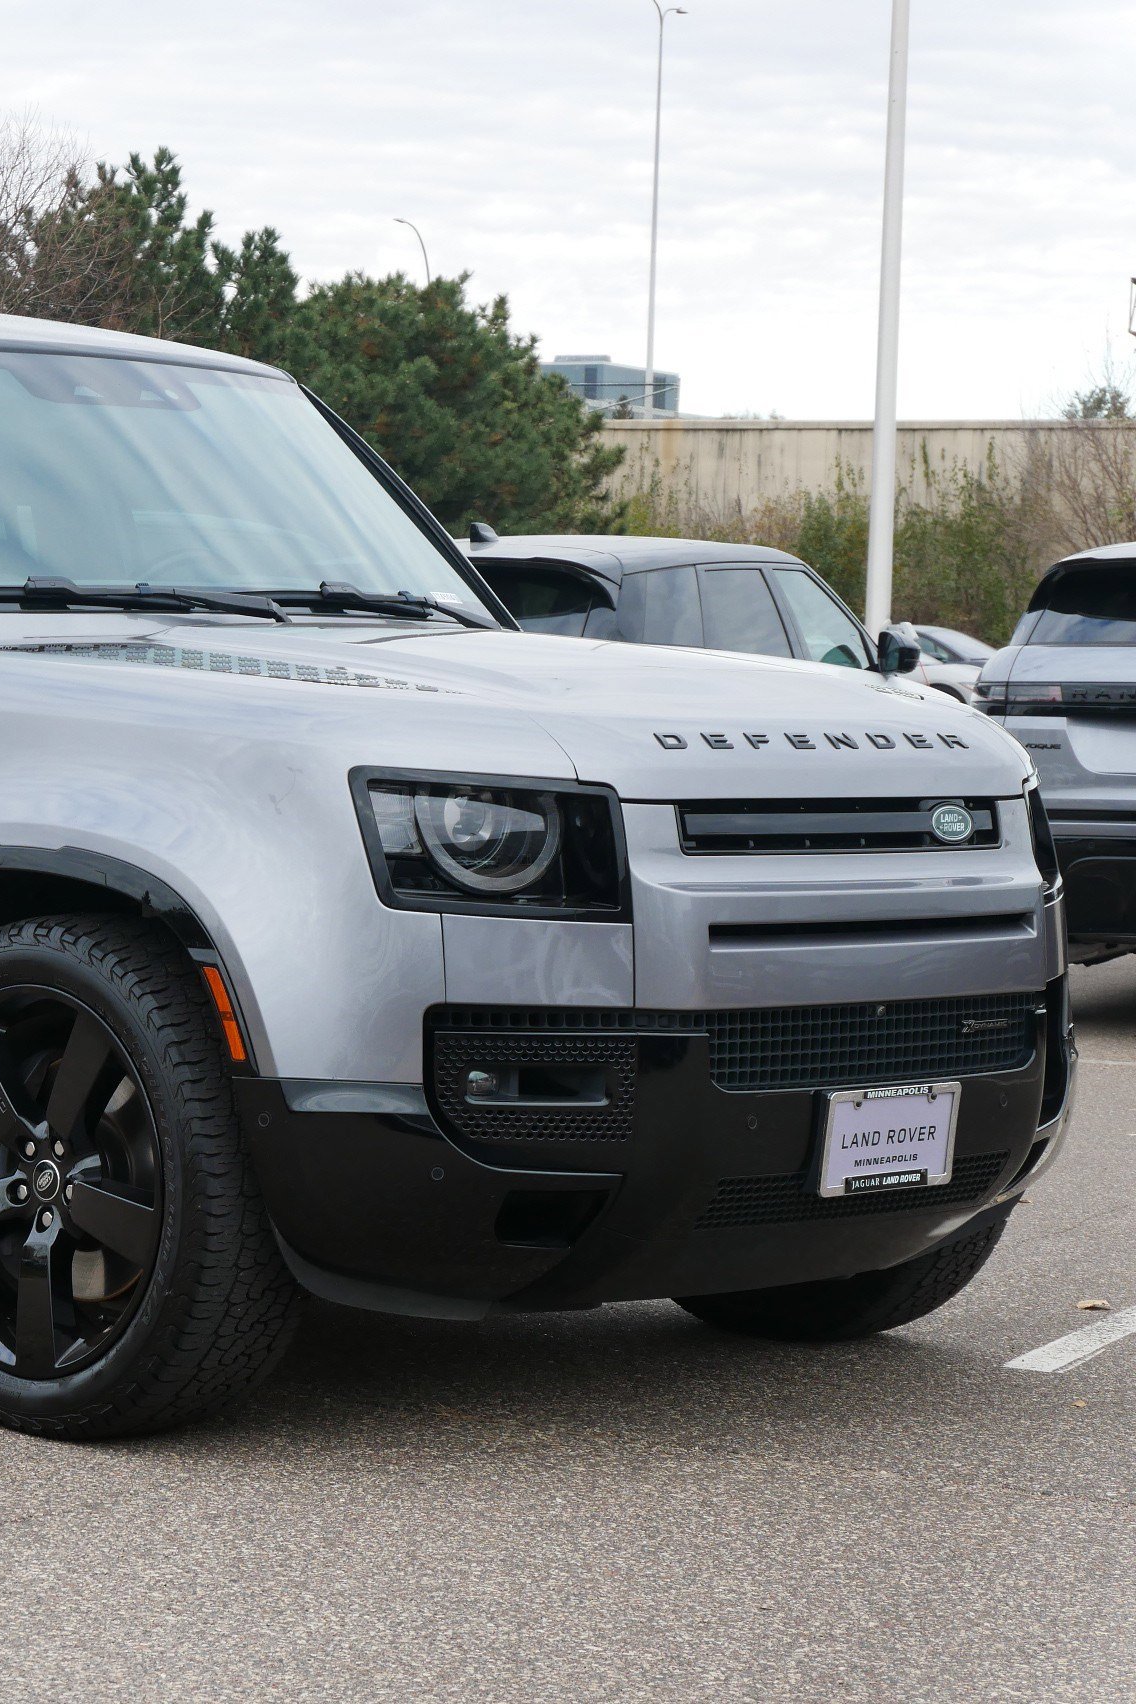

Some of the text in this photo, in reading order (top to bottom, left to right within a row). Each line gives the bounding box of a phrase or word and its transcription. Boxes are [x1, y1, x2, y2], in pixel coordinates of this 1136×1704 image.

[653, 732, 970, 749] DEFENDER
[940, 813, 958, 823] LAND
[943, 822, 965, 832] ROVER
[867, 1086, 929, 1099] MINNEAPOLIS
[841, 1125, 937, 1150] LAND ROVER
[853, 1153, 919, 1168] MINNEAPOLIS
[851, 1173, 921, 1190] JAGUAR LAND ROVER
